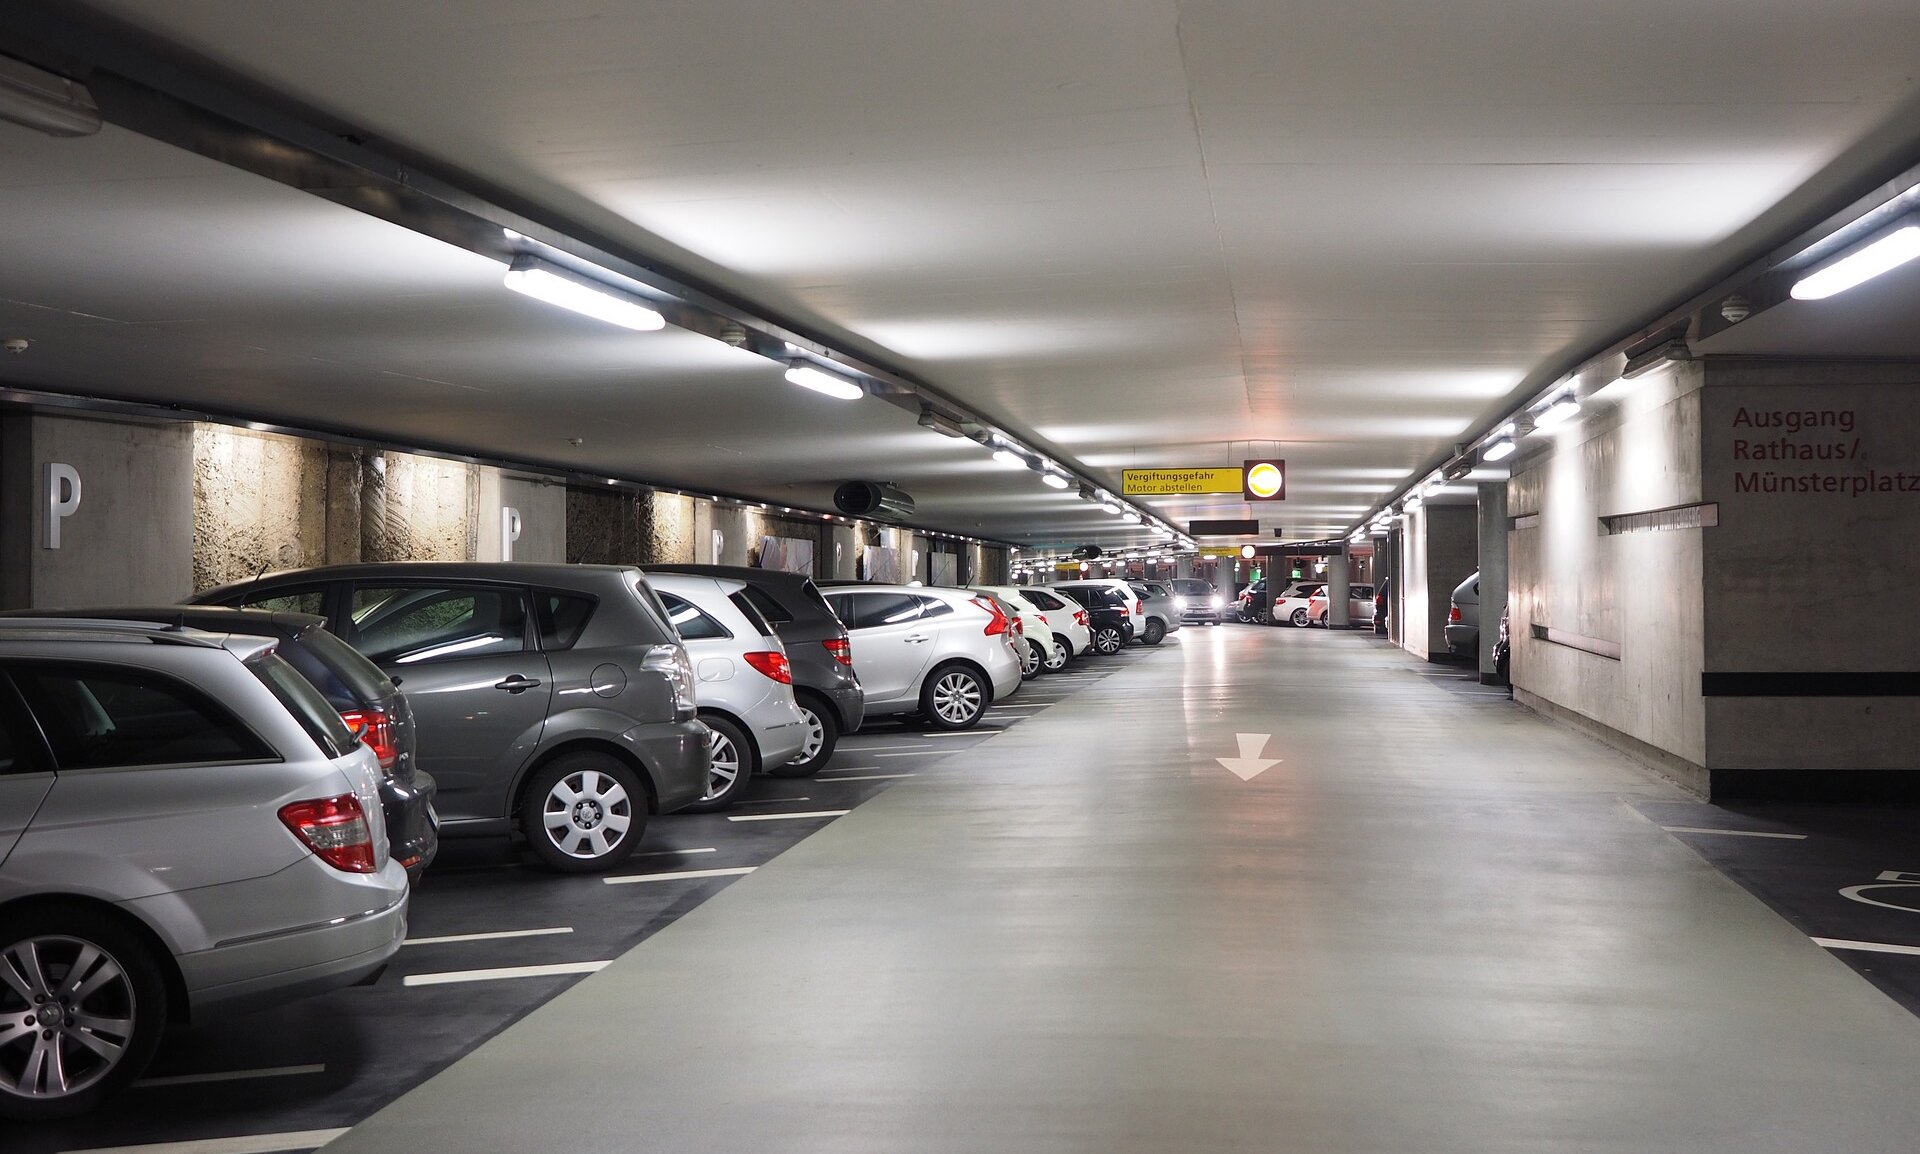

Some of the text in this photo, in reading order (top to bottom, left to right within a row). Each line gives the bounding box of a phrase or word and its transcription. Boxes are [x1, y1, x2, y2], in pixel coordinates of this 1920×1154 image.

[1732, 406, 1855, 433] Ausgang
[1733, 438, 1860, 460] Rathaus/
[1127, 472, 1215, 483] Vergiftungsgefahr
[1127, 482, 1203, 492] Motor abstellen
[1735, 470, 1920, 498] Münsterplatz
[43, 462, 82, 549] P
[502, 506, 522, 562] P
